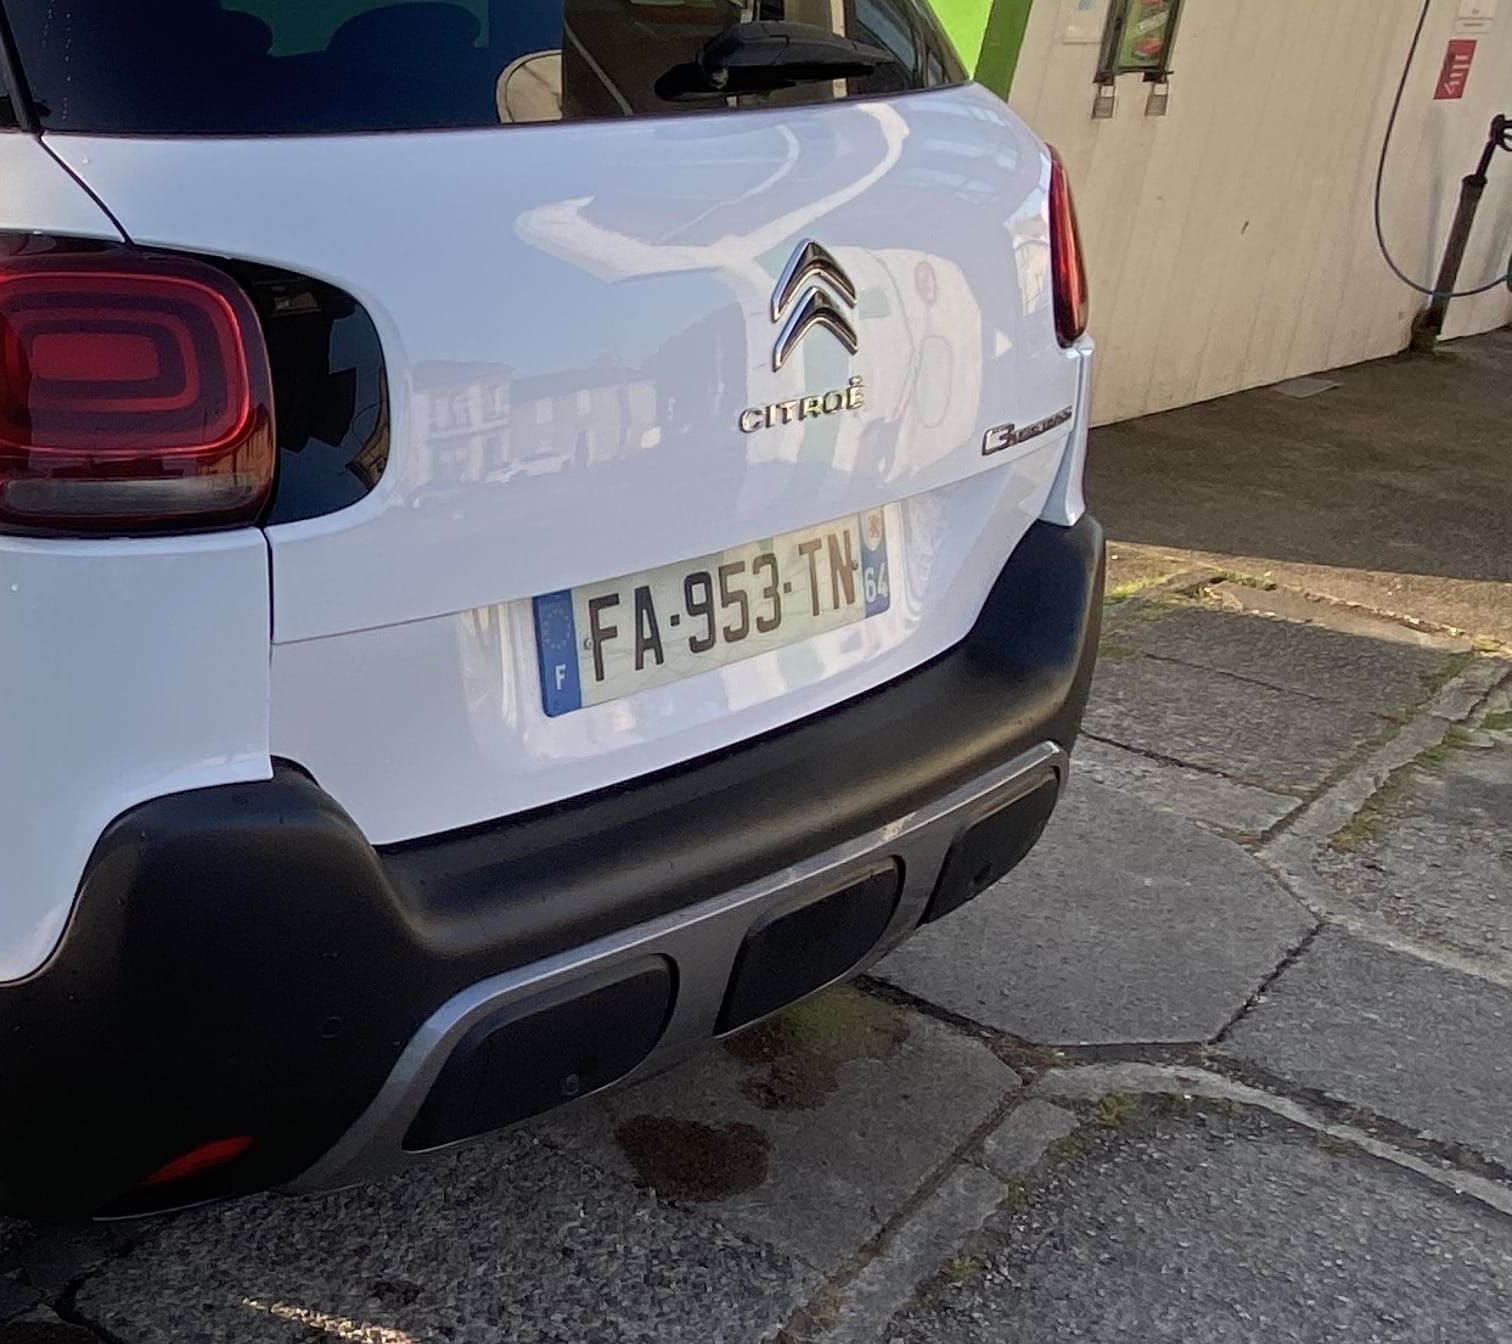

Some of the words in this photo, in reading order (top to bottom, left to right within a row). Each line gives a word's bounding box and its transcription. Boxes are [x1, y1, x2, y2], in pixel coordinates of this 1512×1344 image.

[865, 562, 889, 603] 64
[589, 529, 857, 682] FA-953-TN
[555, 663, 567, 691] F
